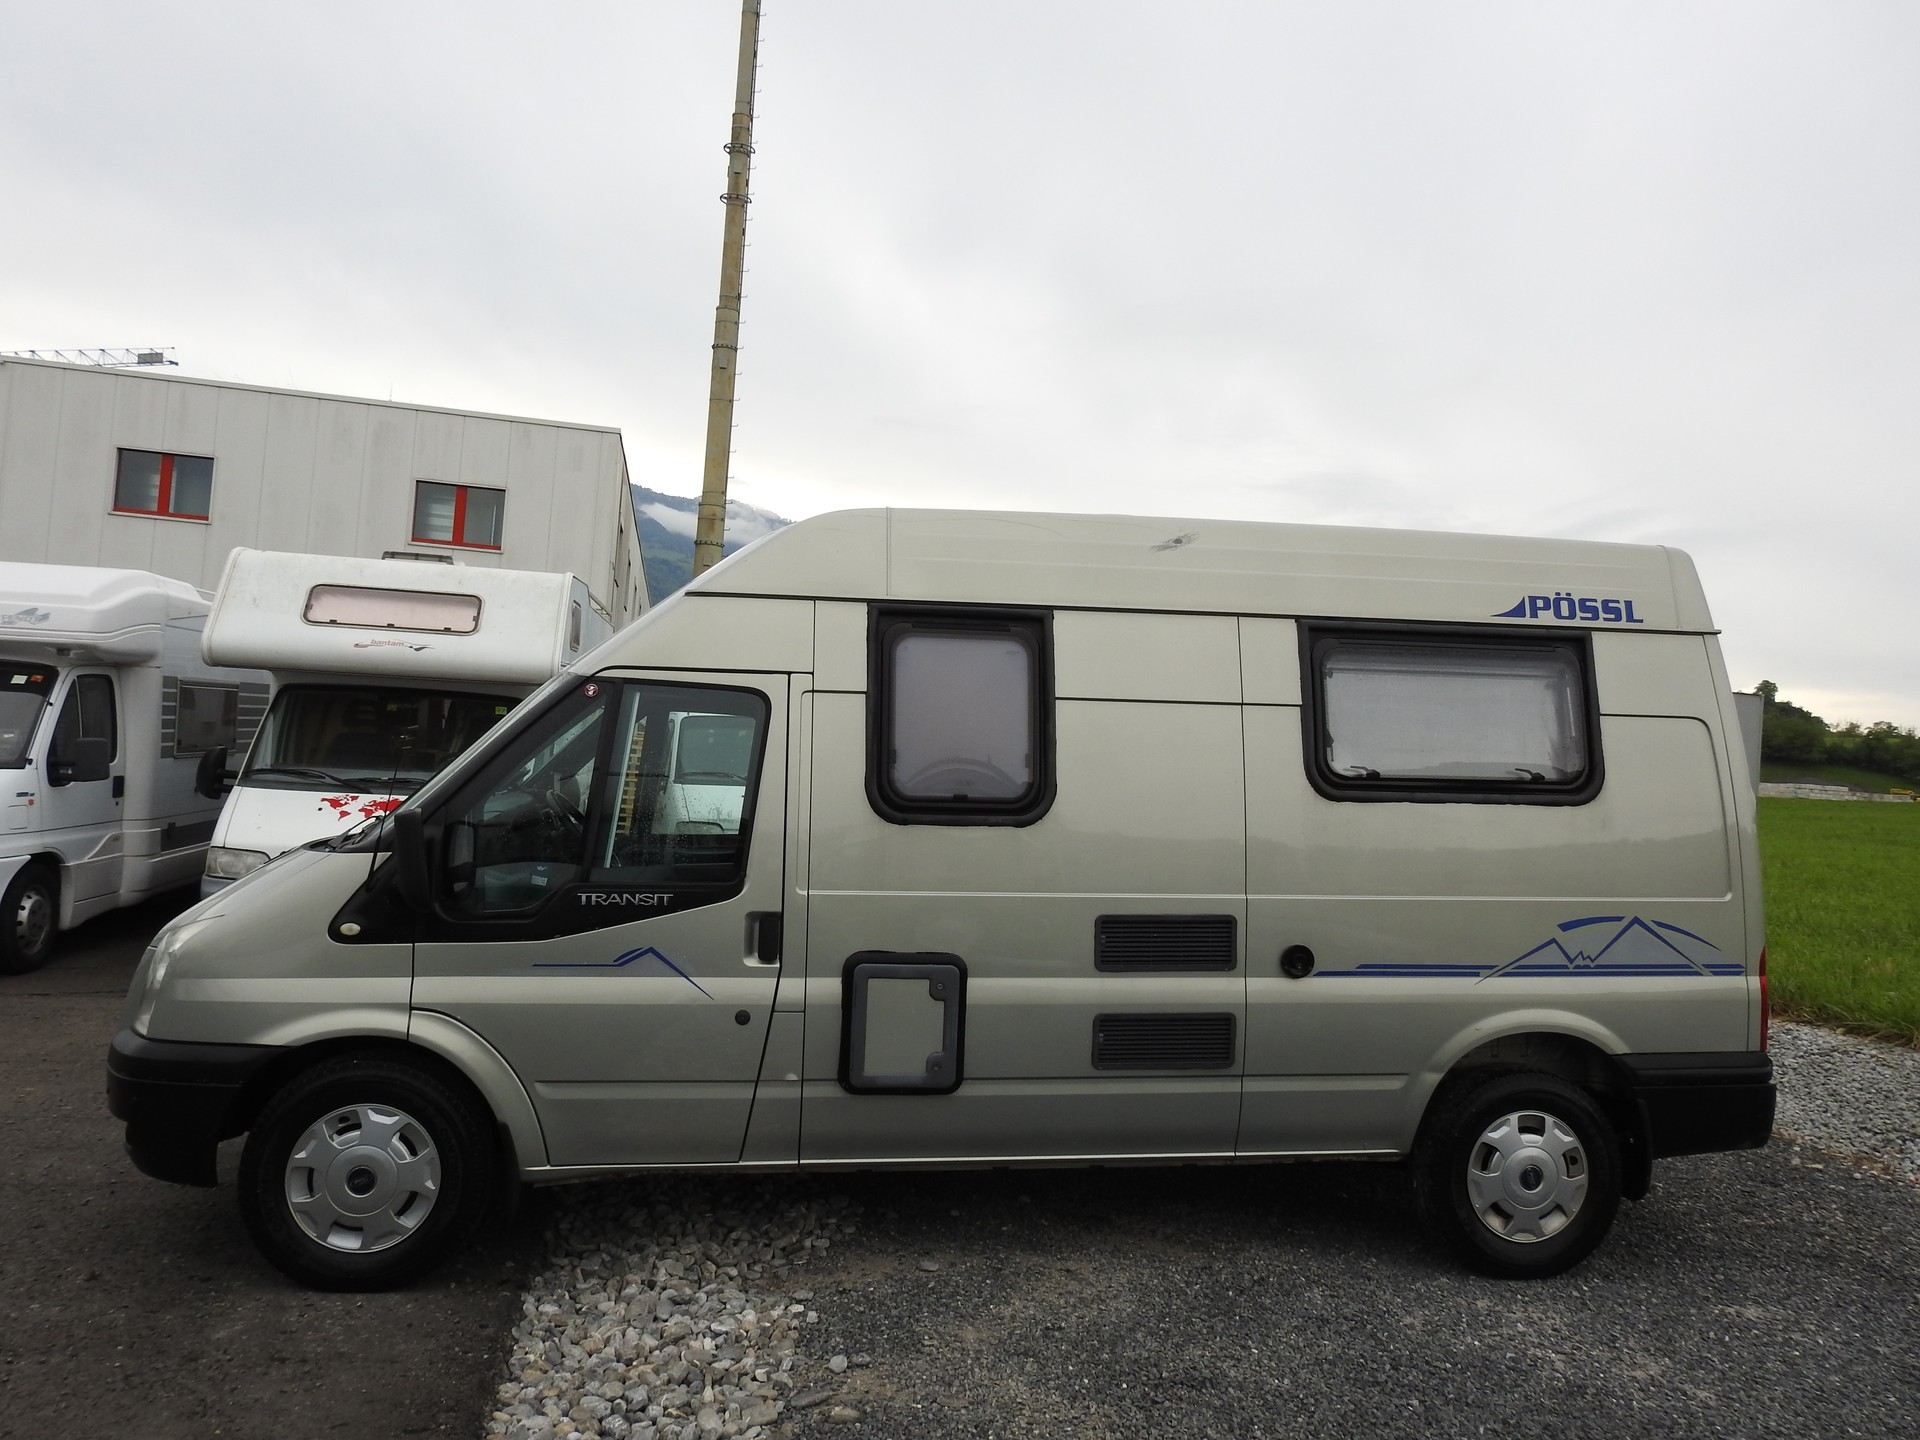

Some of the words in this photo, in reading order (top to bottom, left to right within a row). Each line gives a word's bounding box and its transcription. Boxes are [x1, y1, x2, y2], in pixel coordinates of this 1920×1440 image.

[1528, 592, 1644, 624] PÖSSL
[370, 638, 405, 647] bantam
[577, 893, 674, 906] TRANSIT
